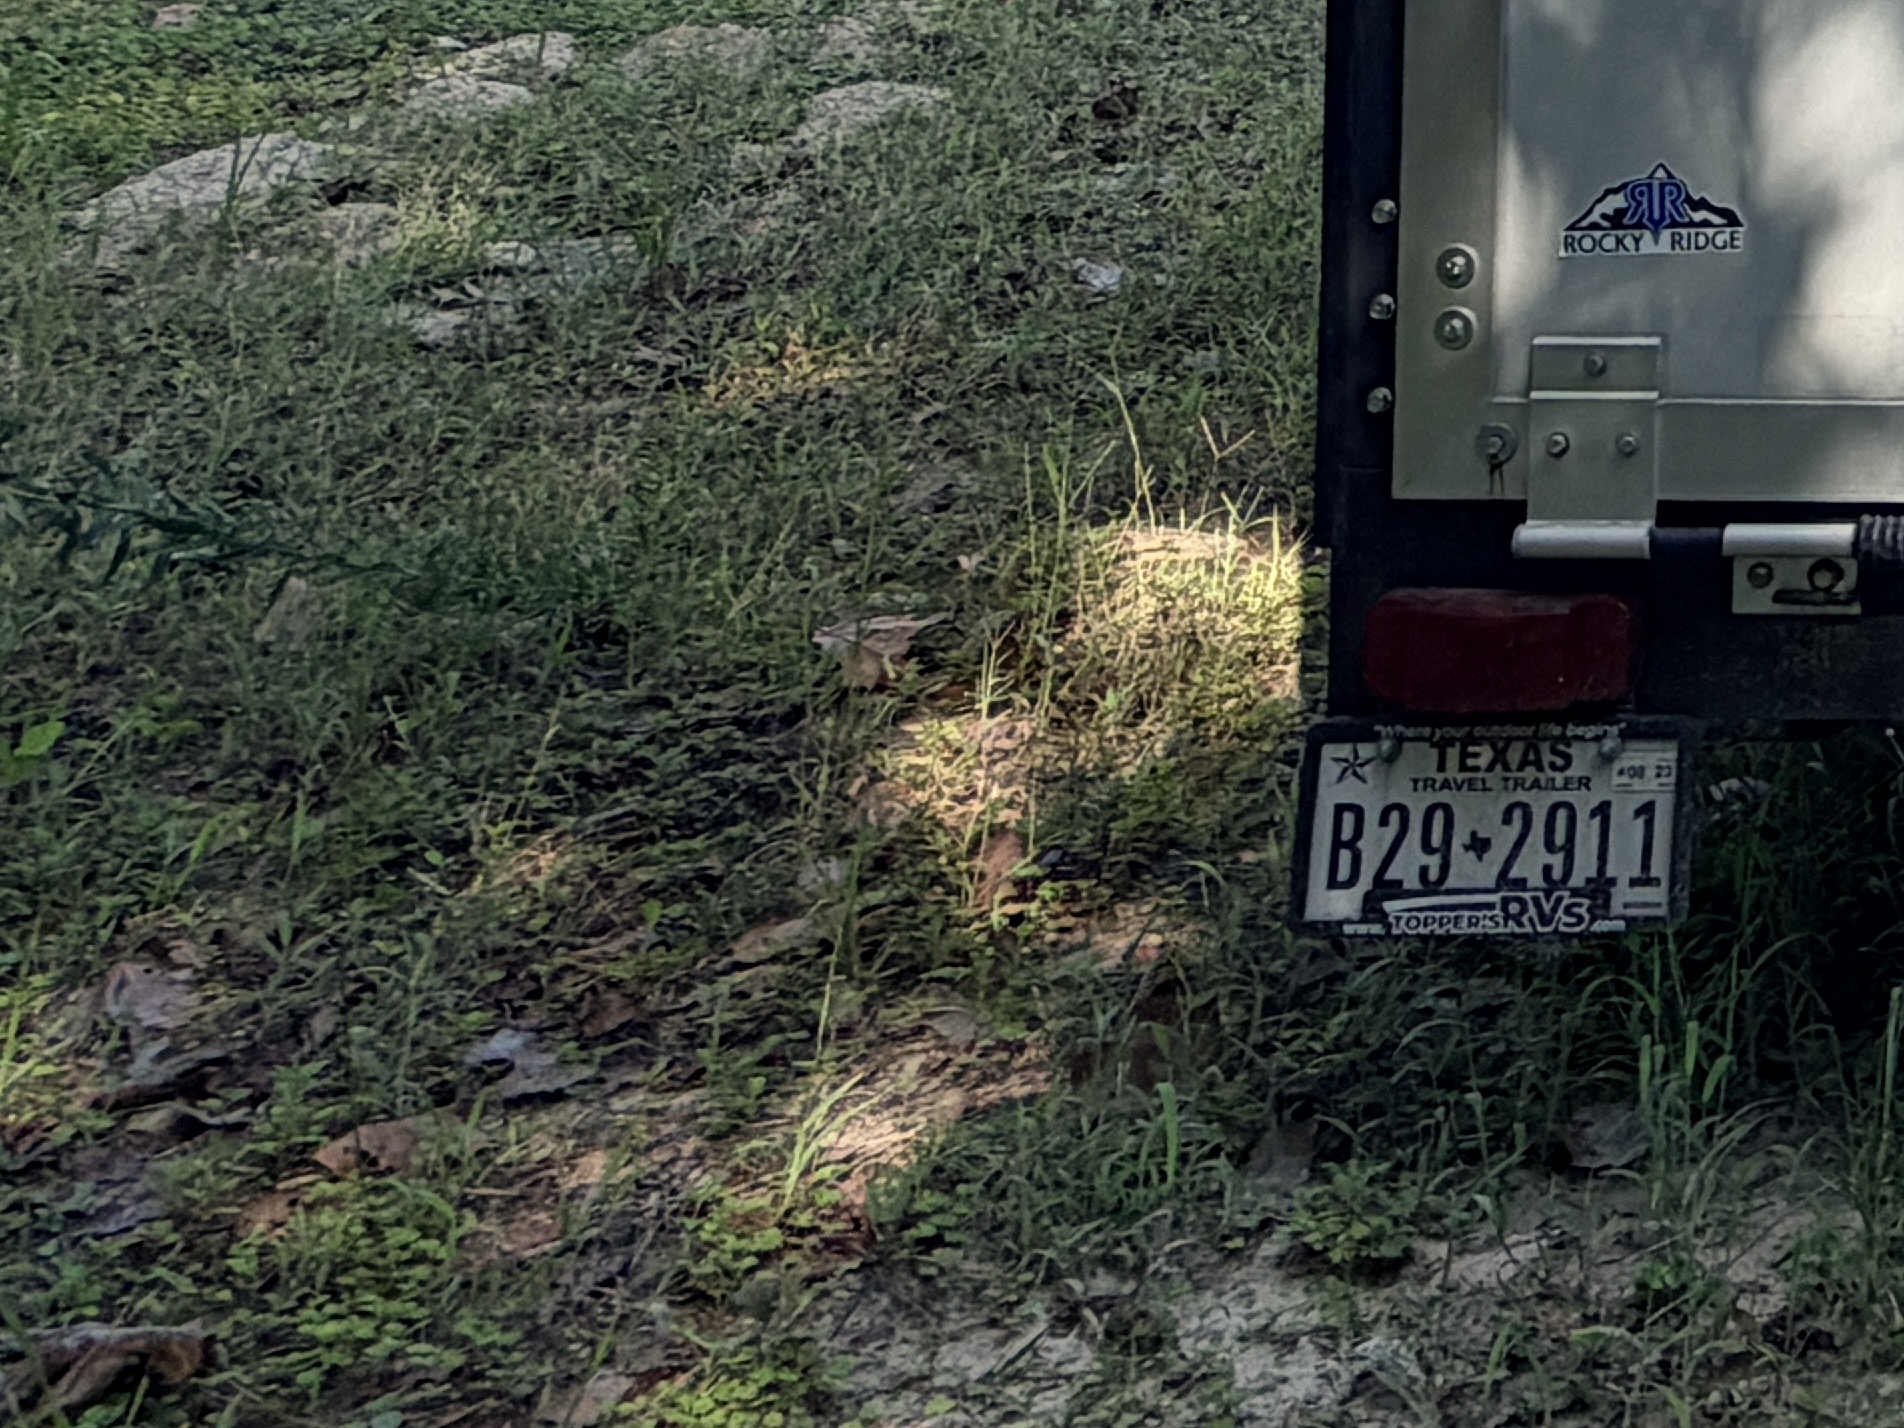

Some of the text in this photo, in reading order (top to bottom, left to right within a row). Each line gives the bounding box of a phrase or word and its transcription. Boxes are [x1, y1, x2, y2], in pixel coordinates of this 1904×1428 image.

[1564, 230, 1742, 254] ROCKY RIDGE
[1429, 740, 1574, 774] TEXAS
[1410, 776, 1592, 793] TRAVEL TRAILER
[1326, 799, 1662, 890] B29 2911
[1392, 913, 1500, 933] TOPPER'S
